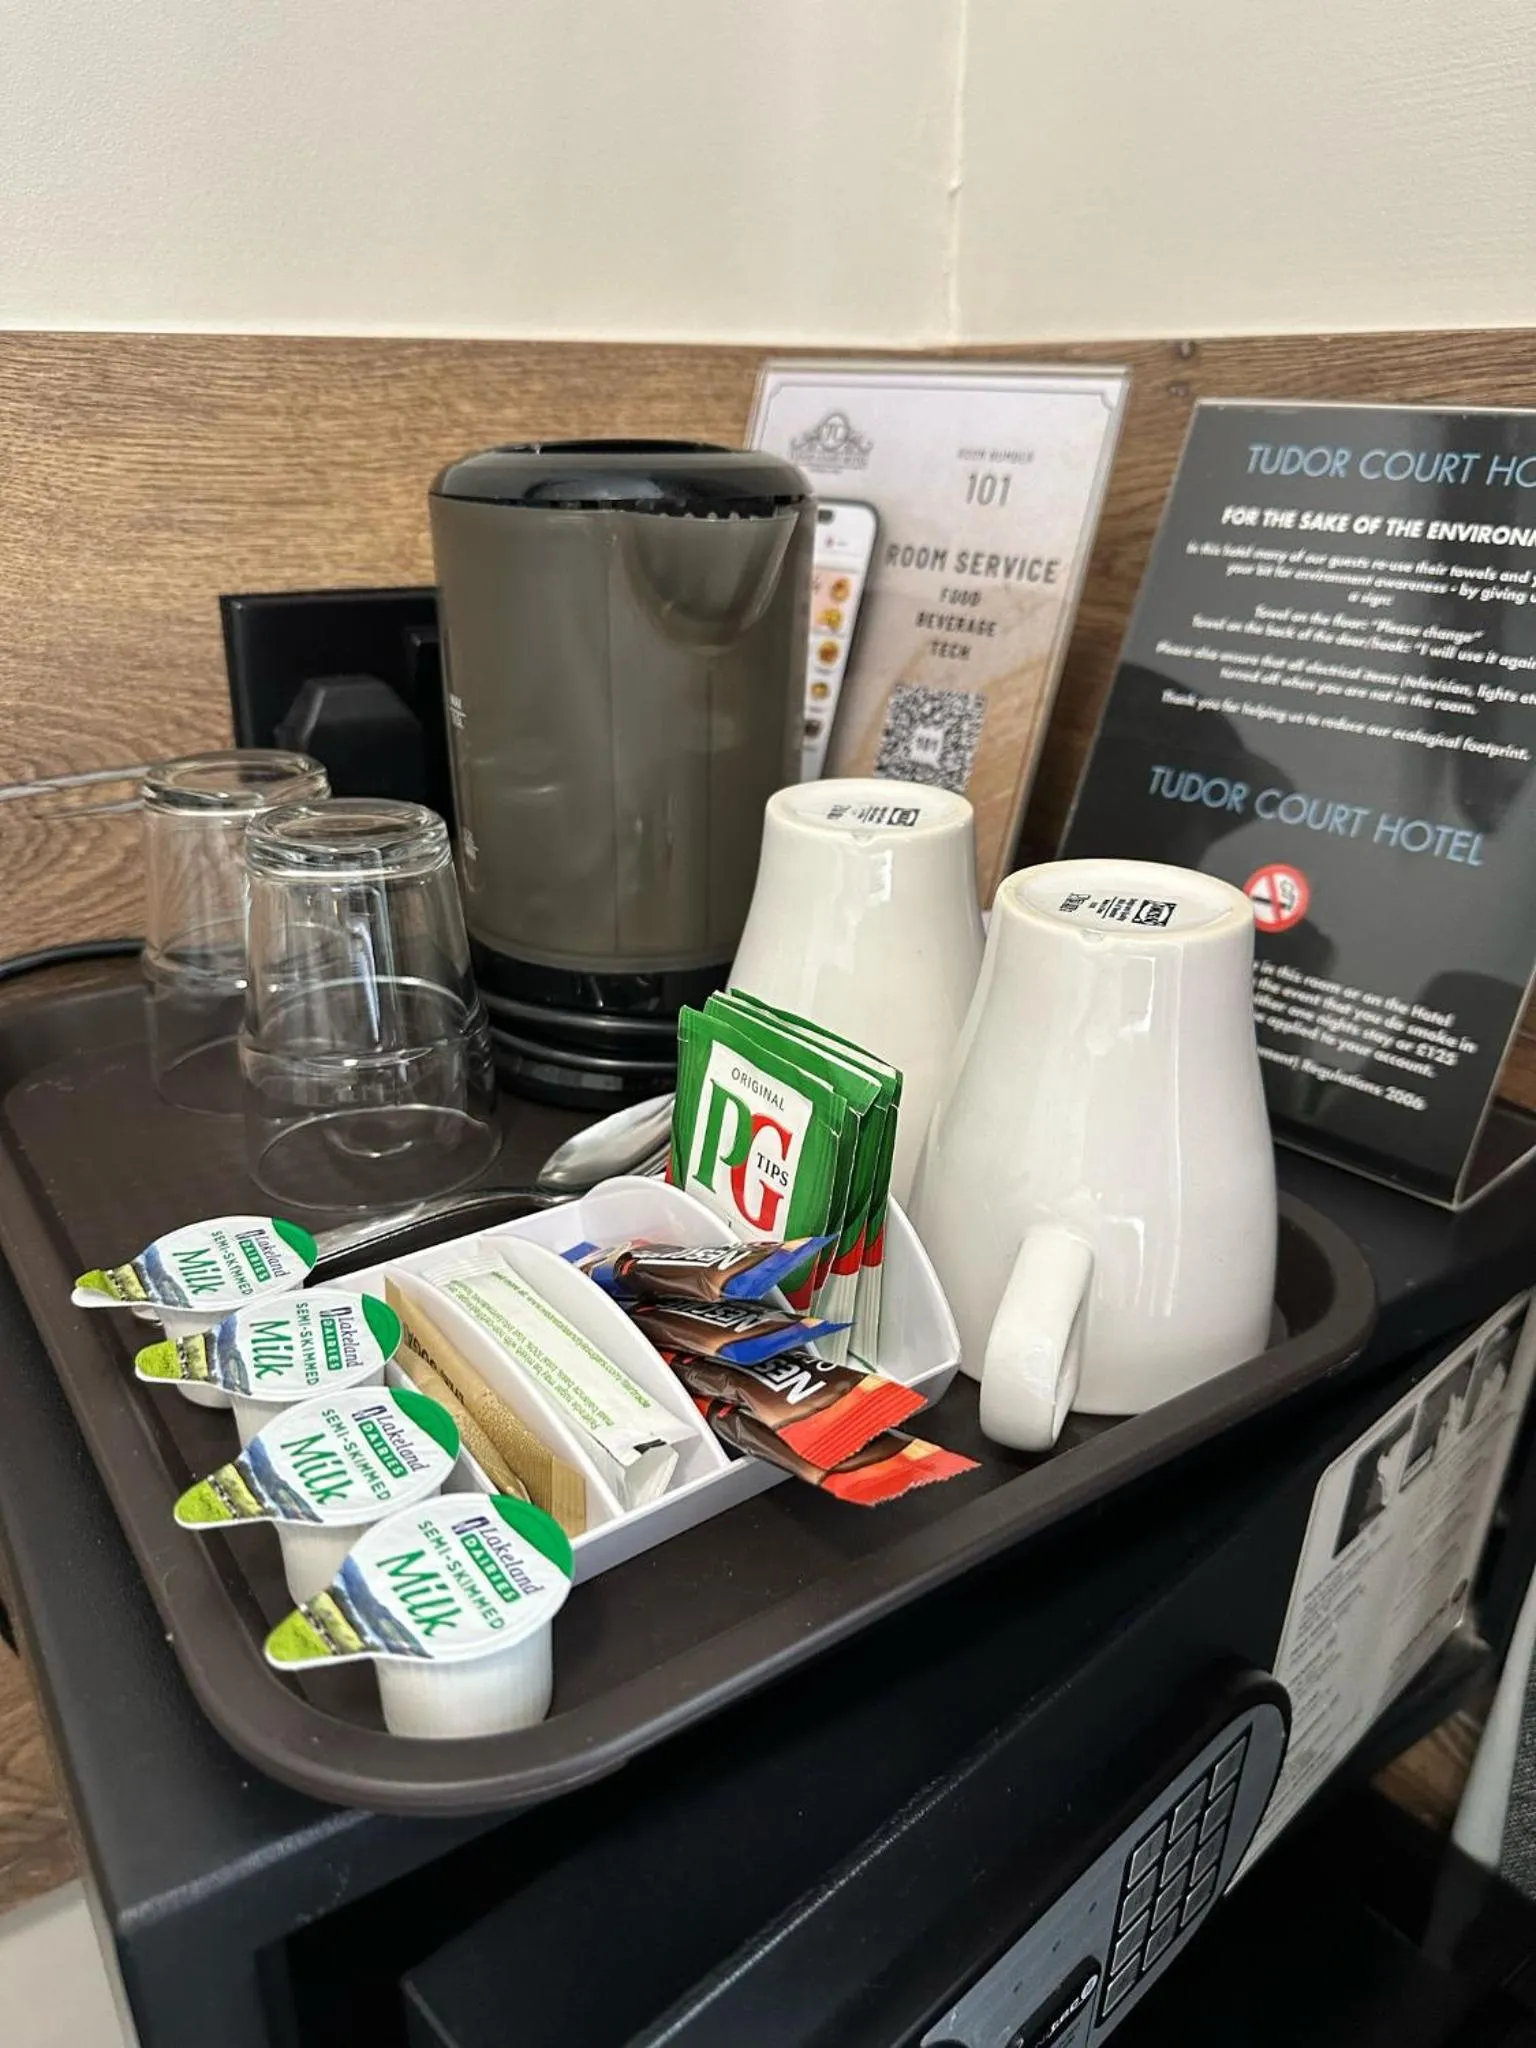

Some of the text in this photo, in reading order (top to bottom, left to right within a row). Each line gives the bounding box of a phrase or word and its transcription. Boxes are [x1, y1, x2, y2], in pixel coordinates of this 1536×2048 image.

[965, 470, 1012, 507] 101
[1247, 444, 1350, 478] TUDOR
[1358, 449, 1480, 484] COURT
[1221, 505, 1260, 526] FOR
[1262, 507, 1297, 529] THE
[1299, 510, 1349, 533] SAKE
[1353, 514, 1383, 535] OF
[1386, 516, 1423, 539] THE
[886, 543, 1062, 585] ROOM SERVICE
[1415, 560, 1449, 576] their
[1450, 564, 1498, 581] towels
[1500, 569, 1531, 584] and
[939, 587, 983, 608] FOOD
[1459, 581, 1480, 600] by
[1480, 586, 1529, 605] giving
[915, 610, 998, 638] BEVERAGE
[929, 639, 971, 660] TECH
[1430, 644, 1459, 660] will
[1458, 651, 1485, 663] use
[1485, 650, 1500, 664] it
[1410, 692, 1435, 708] the
[1476, 683, 1520, 703] lights
[1392, 728, 1465, 749] ecological
[1462, 735, 1532, 761] footprint.
[1148, 765, 1485, 867] TUDOR COURT HOTEL
[1304, 976, 1343, 994] room
[1343, 986, 1363, 999] or
[1384, 997, 1410, 1015] the
[1410, 1004, 1455, 1028] Hotel
[1322, 996, 1353, 1015] that
[1353, 1008, 1384, 1025] you
[1384, 1015, 1407, 1031] do
[1407, 1024, 1458, 1048] smoke
[1459, 1036, 1478, 1053] in
[731, 1067, 785, 1112] ORIGINAL
[1301, 1057, 1385, 1097] Regulations
[1384, 1085, 1428, 1111] 2006
[692, 1078, 793, 1232] PG
[756, 1151, 789, 1187] TIPS
[172, 1248, 225, 1296] Milk
[211, 1231, 253, 1295] SEMI-SKIMMED
[240, 1240, 270, 1283] DAIRIES
[255, 1236, 291, 1279] Lakeland
[250, 1319, 294, 1380] Milk
[296, 1302, 319, 1386] SEMI-SKIMMED
[321, 1319, 342, 1370] DAIRIES
[338, 1311, 364, 1369] Lakeland
[321, 1407, 391, 1501] SEMI-SKIMMED
[359, 1421, 408, 1478] DAIRIES
[377, 1413, 431, 1472] Lakeland
[280, 1433, 354, 1505] Milk
[417, 1519, 505, 1631] SEMI-SKIMMED
[461, 1534, 521, 1604] DAIRIES
[480, 1526, 546, 1595] Lakeland
[376, 1549, 464, 1638] Milk
